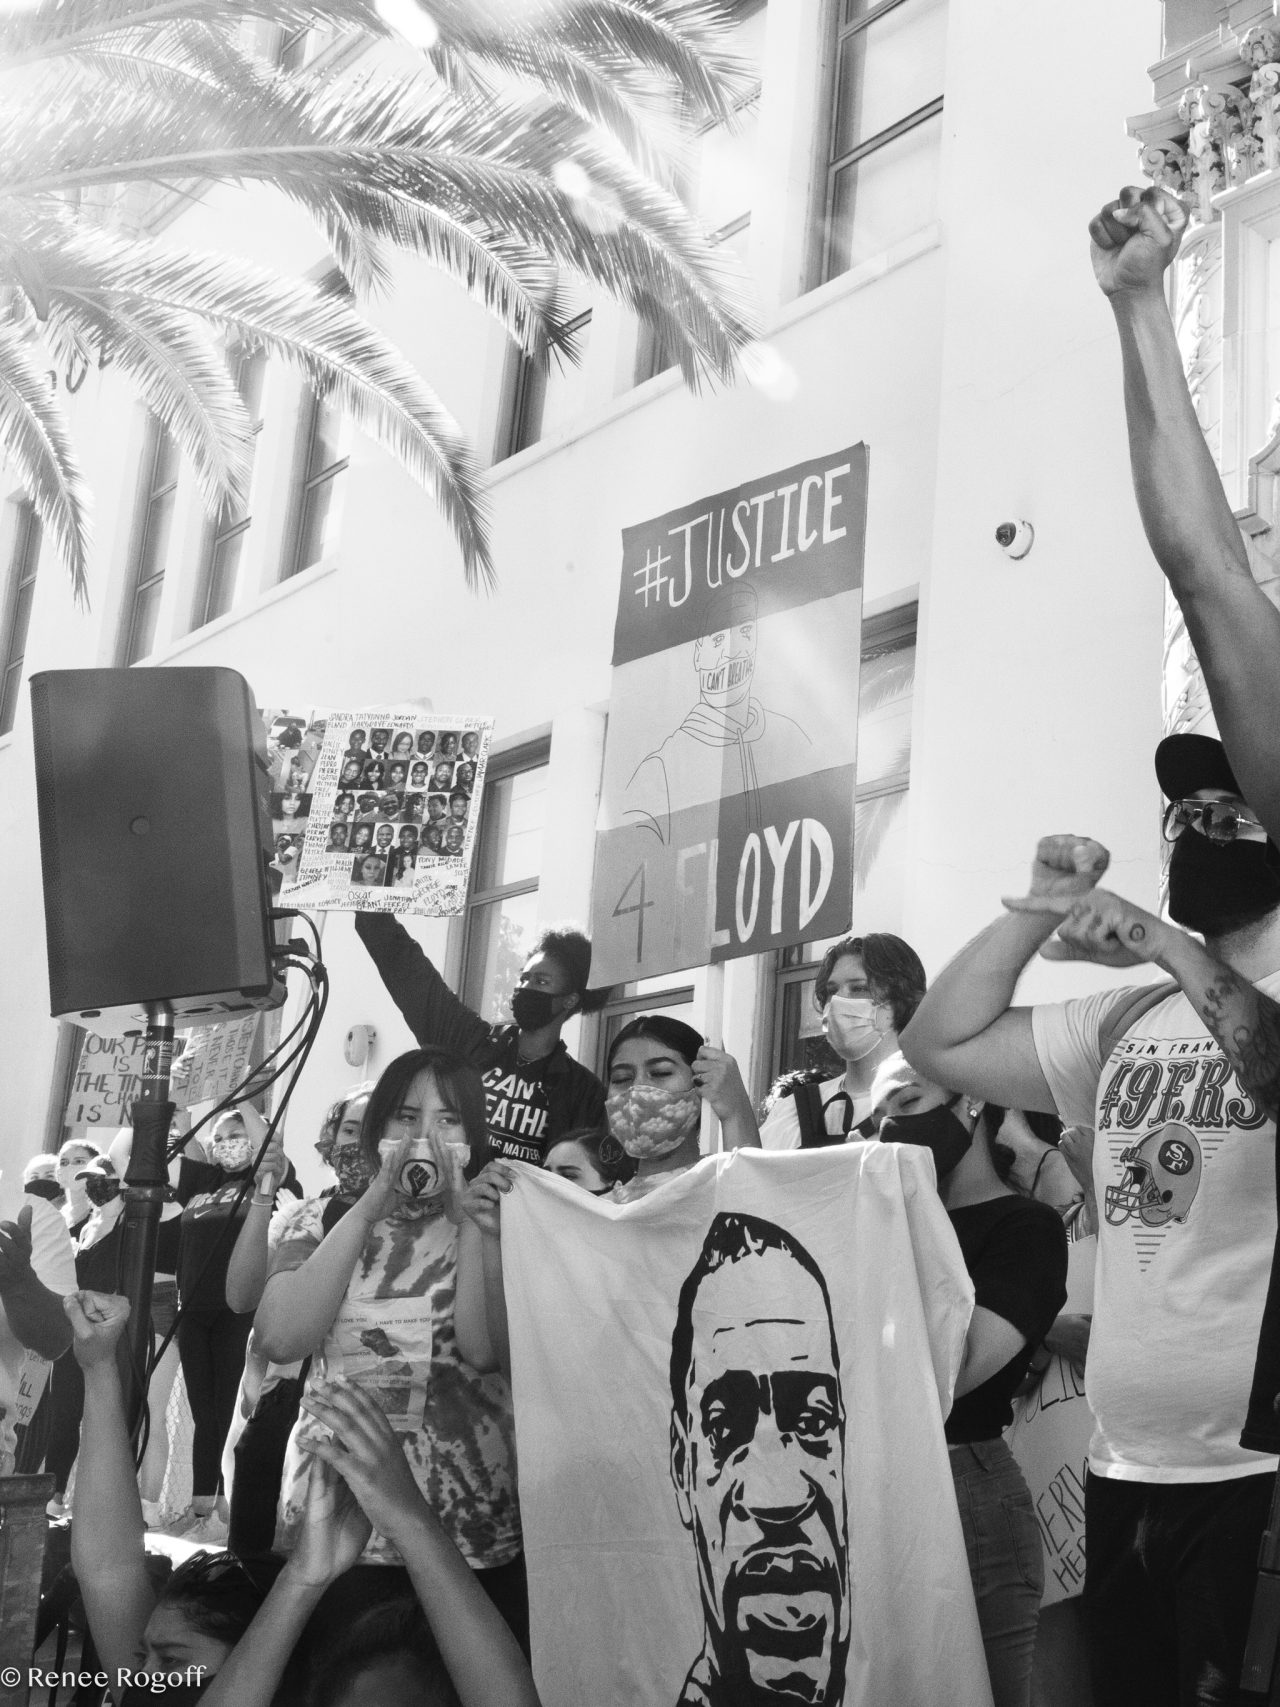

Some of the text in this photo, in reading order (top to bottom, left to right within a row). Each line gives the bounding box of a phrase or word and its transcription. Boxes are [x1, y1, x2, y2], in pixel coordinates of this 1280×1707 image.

[633, 463, 851, 608] #JUSTICE
[727, 657, 753, 688] BREATHE
[611, 817, 834, 964] 4 FLOYD
[84, 1032, 125, 1056] OUR
[1167, 1040, 1222, 1056] FRAN
[112, 1055, 131, 1073] IS
[75, 1071, 112, 1093] THE
[1098, 1055, 1269, 1131] 49ERS
[76, 1103, 102, 1123] IS
